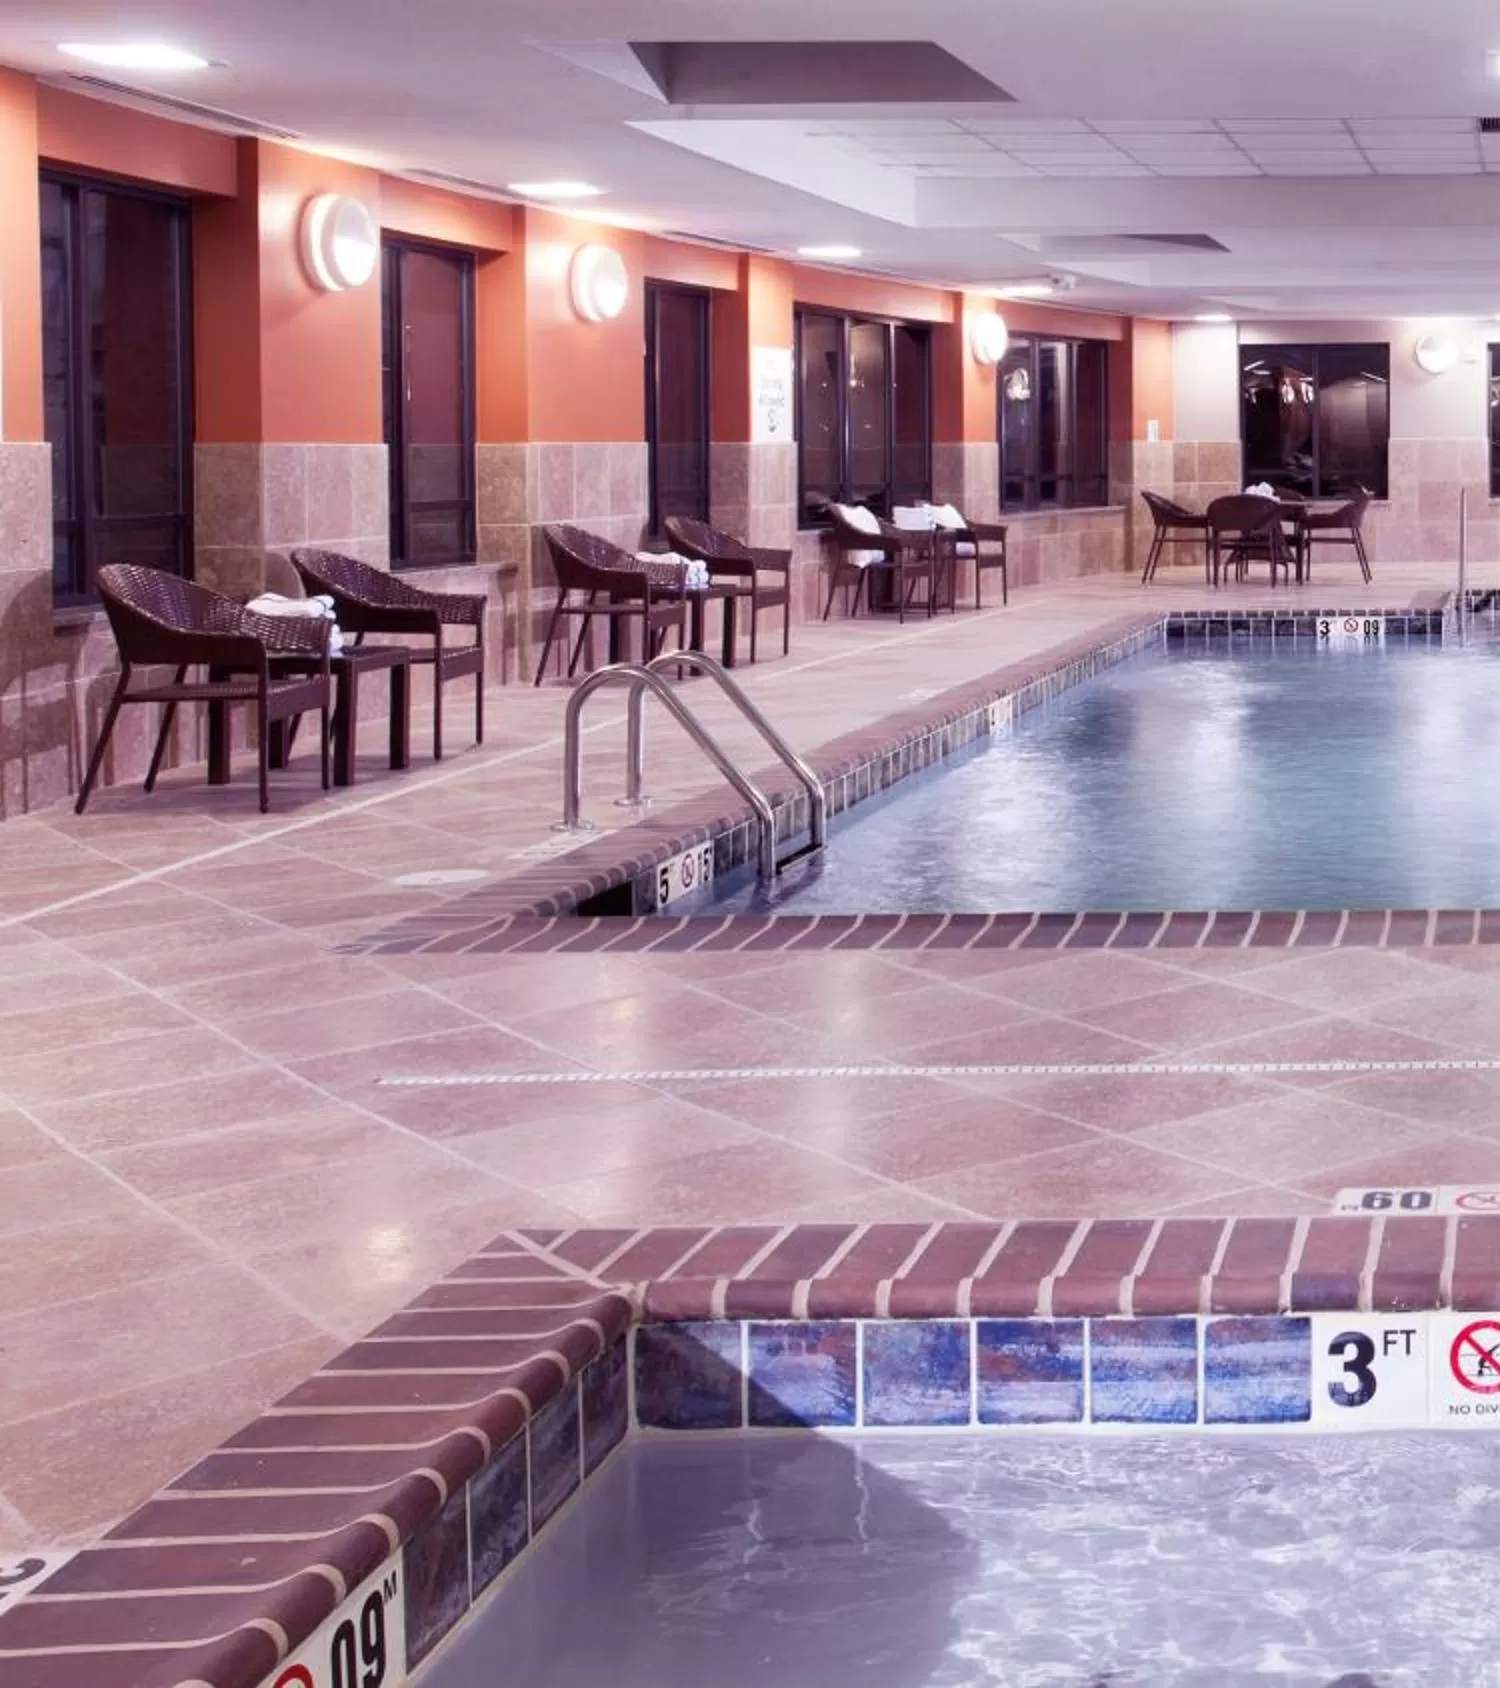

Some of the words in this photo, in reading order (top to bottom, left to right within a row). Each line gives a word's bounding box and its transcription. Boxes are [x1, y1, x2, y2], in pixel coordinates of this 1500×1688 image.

[1320, 619, 1330, 636] 3
[659, 866, 669, 904] 5
[1327, 1330, 1378, 1408] 3
[1382, 1328, 1417, 1357] FT
[1448, 1404, 1471, 1416] NO
